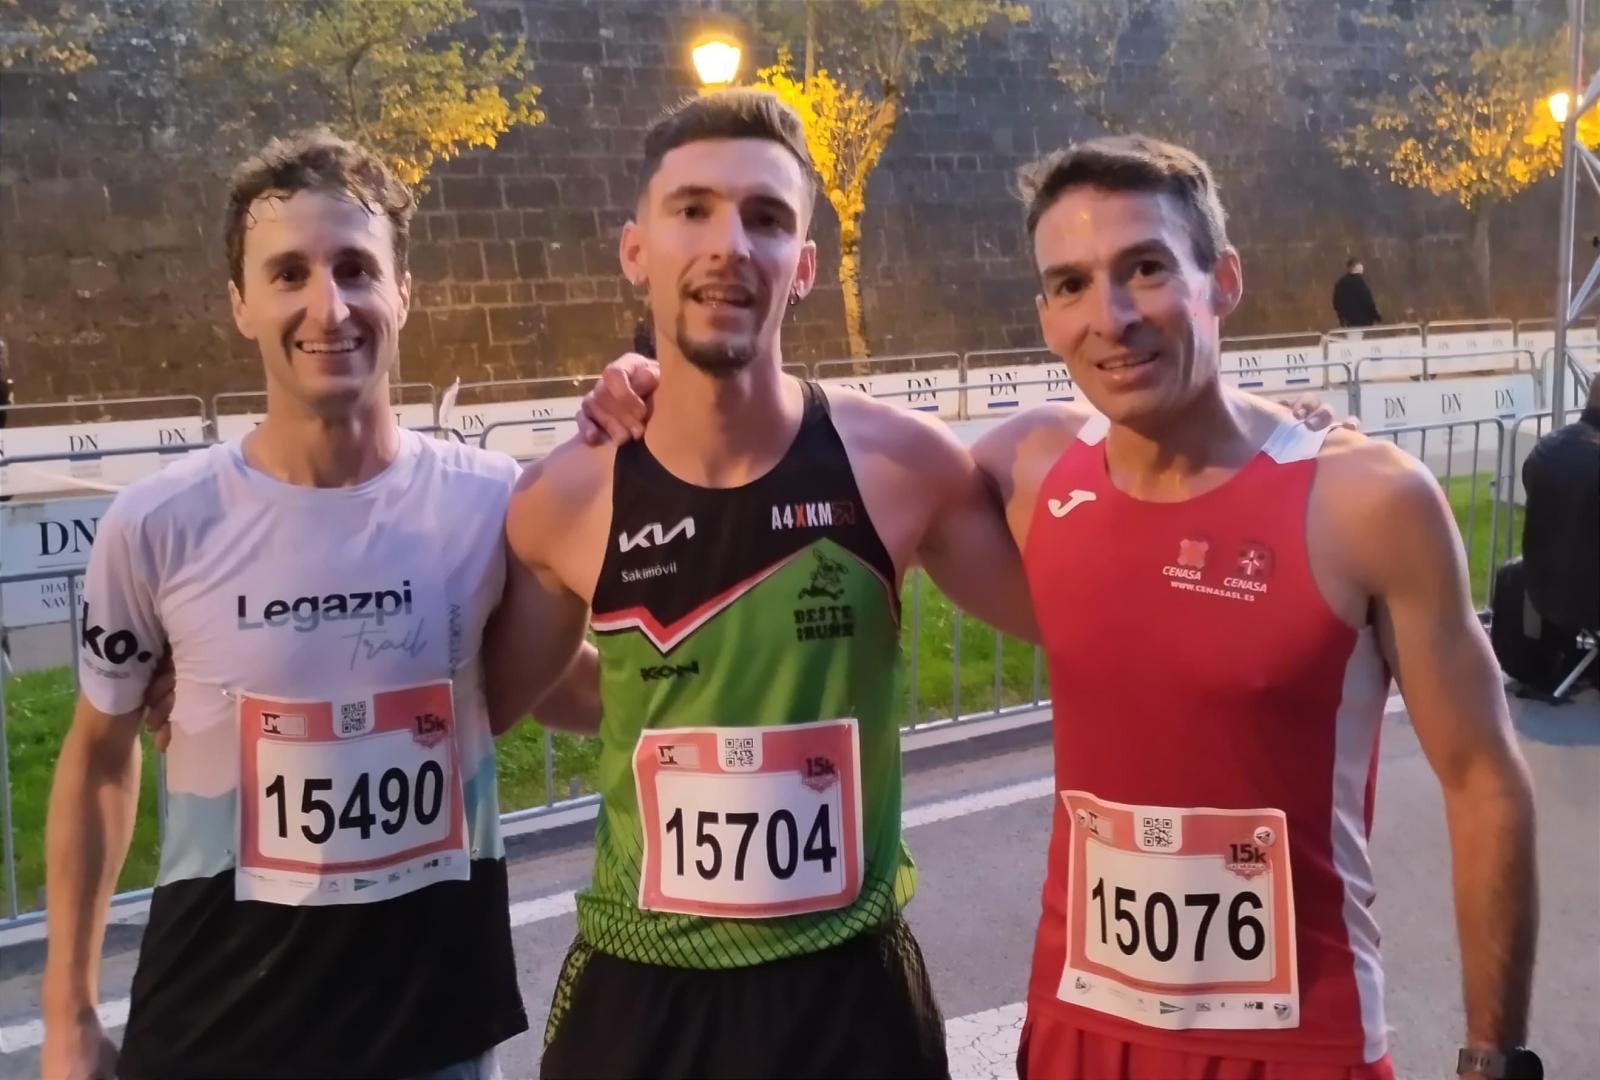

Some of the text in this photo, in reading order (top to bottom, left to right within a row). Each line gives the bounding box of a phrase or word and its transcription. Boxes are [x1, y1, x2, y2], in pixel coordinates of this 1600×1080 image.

[907, 377, 937, 402] DN
[989, 372, 1018, 396] DN
[1047, 368, 1073, 392] DN
[1384, 397, 1407, 418] DN
[1441, 393, 1463, 414] DN
[1495, 388, 1515, 409] DN
[462, 413, 486, 431] DN
[69, 434, 99, 452] DN
[159, 428, 187, 446] DN
[38, 517, 98, 556] DN
[1162, 565, 1202, 581] CENASA
[1223, 577, 1268, 593] CENASA
[237, 580, 413, 633] Legazpi
[415, 713, 447, 735] 15k
[805, 756, 836, 777] 15k
[265, 760, 444, 845] 15490
[665, 803, 837, 881] 15704
[1229, 843, 1267, 864] 15k
[1092, 877, 1266, 963] 15076
